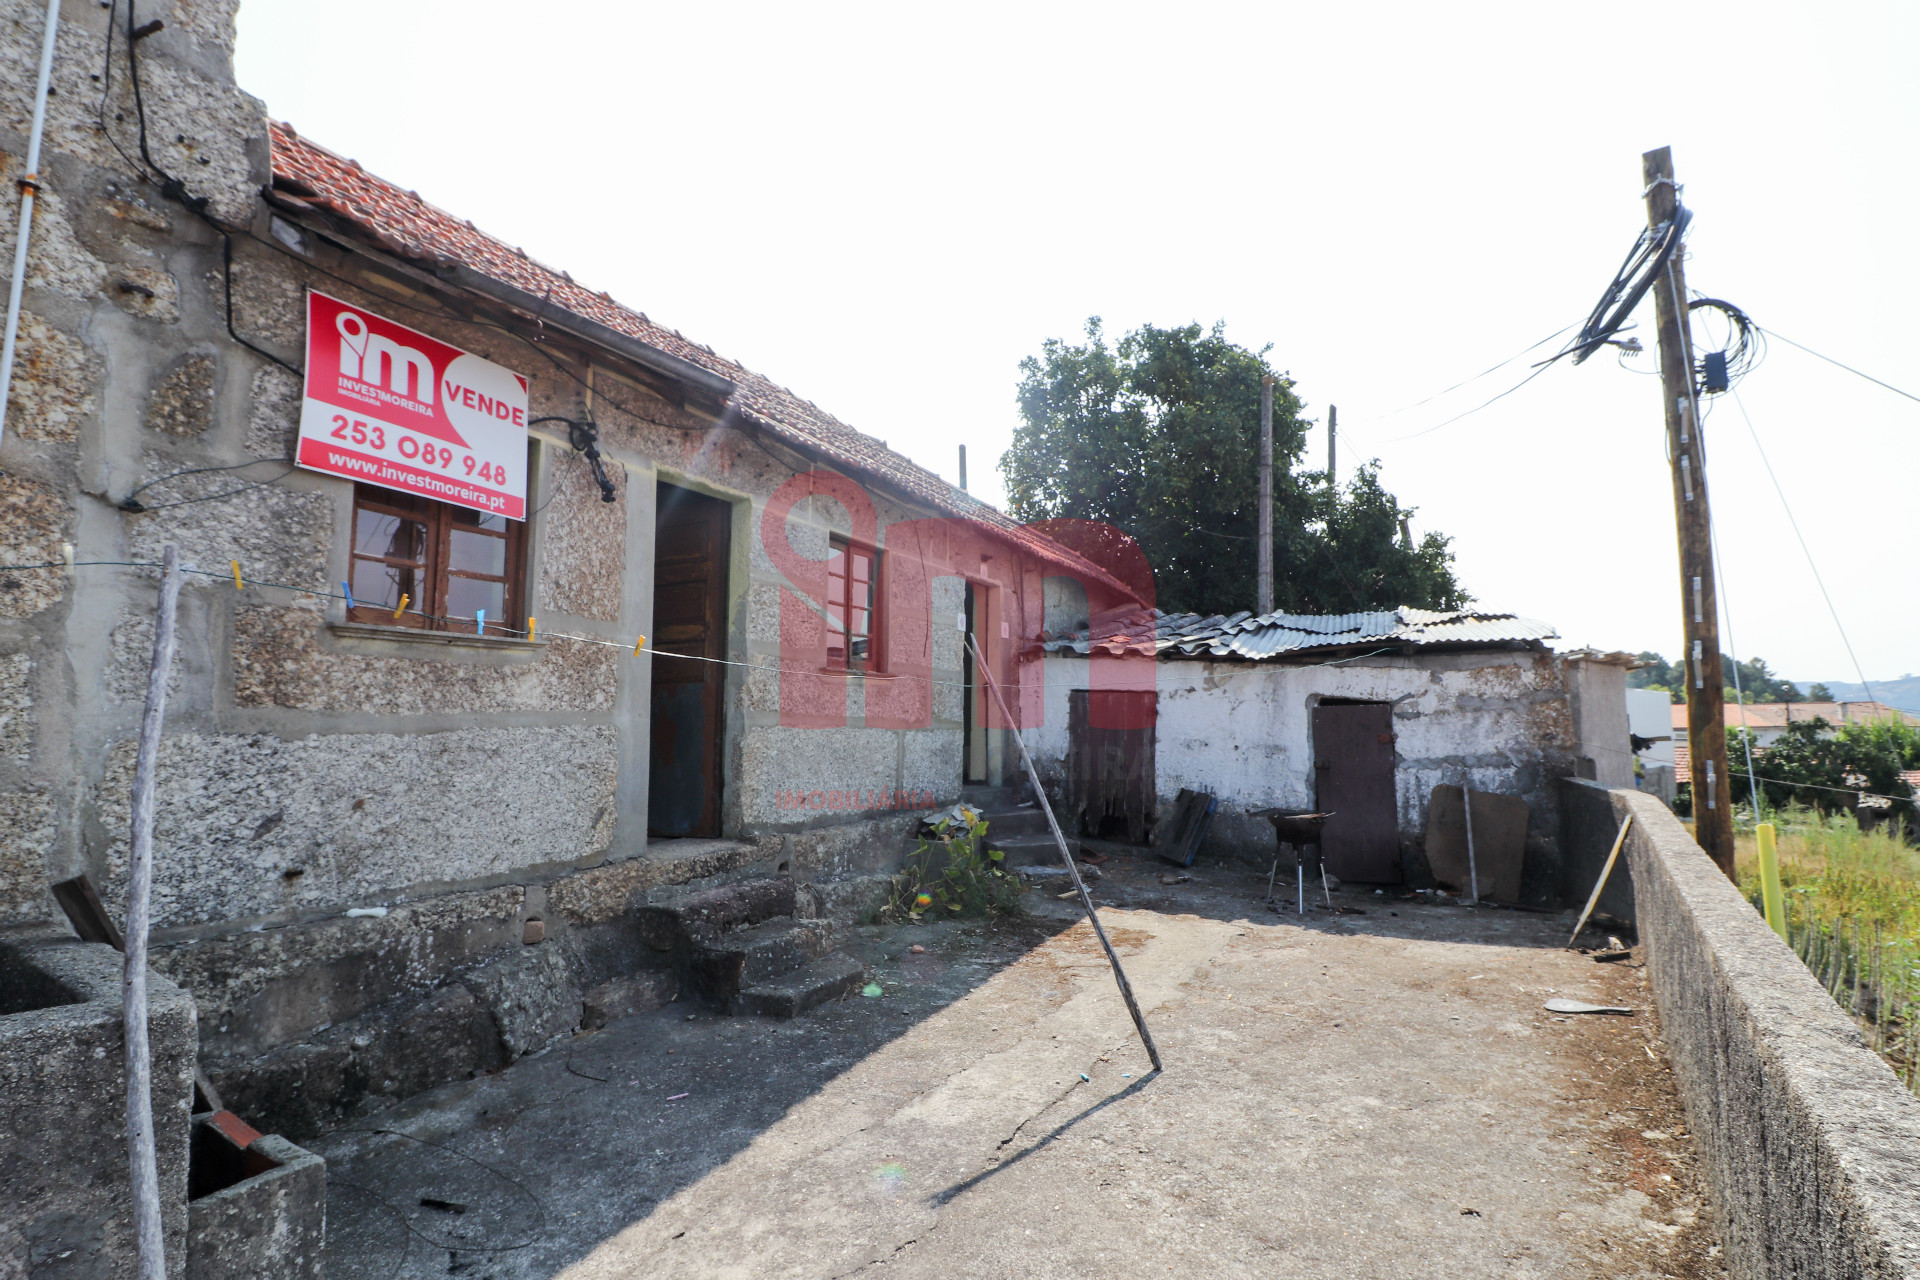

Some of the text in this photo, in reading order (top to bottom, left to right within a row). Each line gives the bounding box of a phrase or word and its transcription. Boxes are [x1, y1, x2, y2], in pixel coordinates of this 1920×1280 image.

[338, 376, 434, 418] INVESTMOREIRA
[444, 379, 524, 427] VENDE
[330, 414, 507, 486] 253 089 948
[328, 452, 505, 510] www.investmoreira.pt
